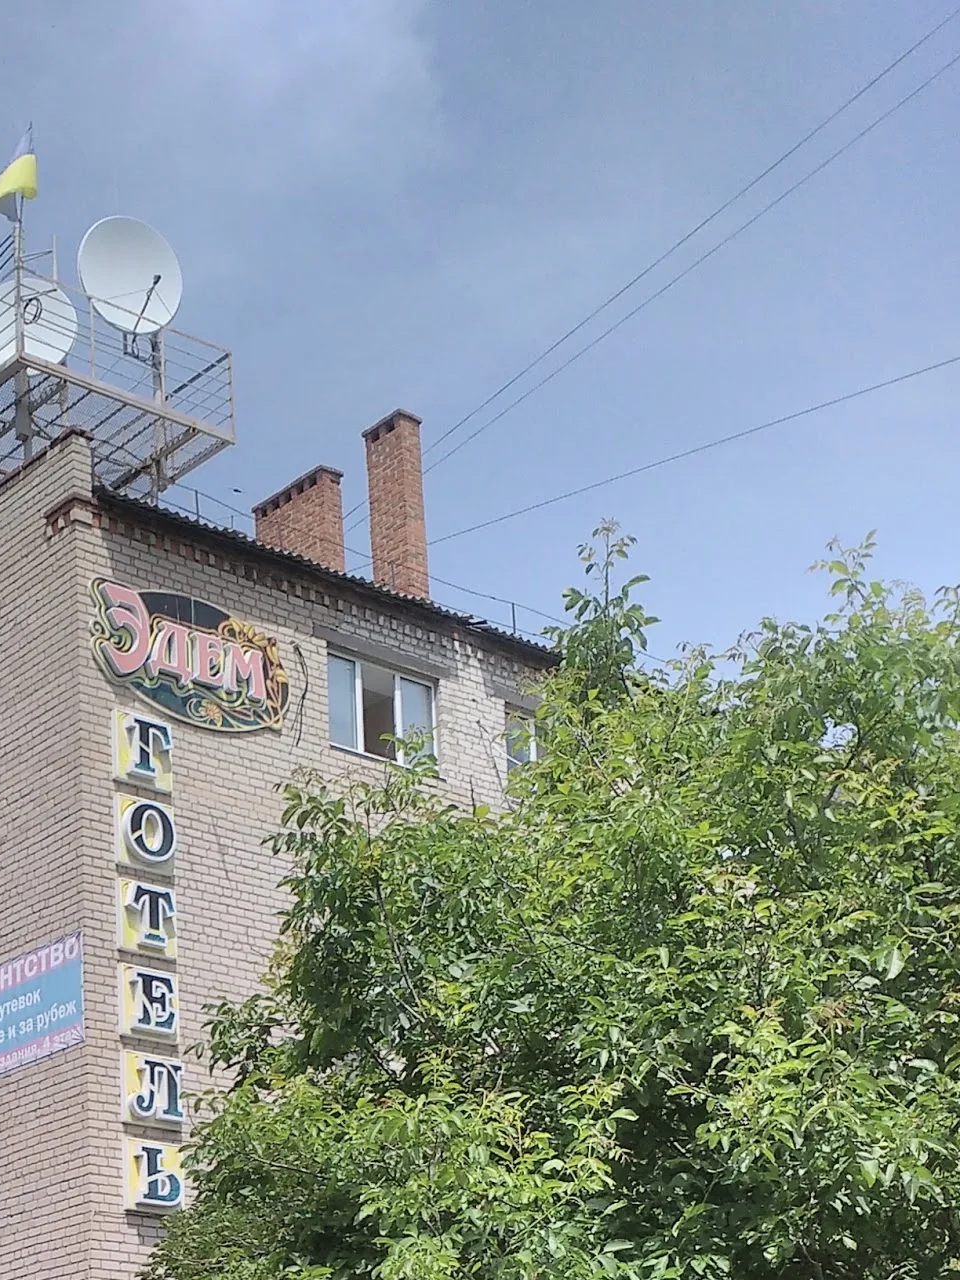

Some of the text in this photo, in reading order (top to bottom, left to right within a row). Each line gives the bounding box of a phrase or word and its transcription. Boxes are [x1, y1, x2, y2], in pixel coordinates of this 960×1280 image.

[123, 713, 184, 1207] ГОТЕЛЬ
[8, 1026, 15, 1039] и
[19, 1019, 33, 1034] за
[37, 1000, 77, 1032] рубеж
[44, 1036, 51, 1047] 4
